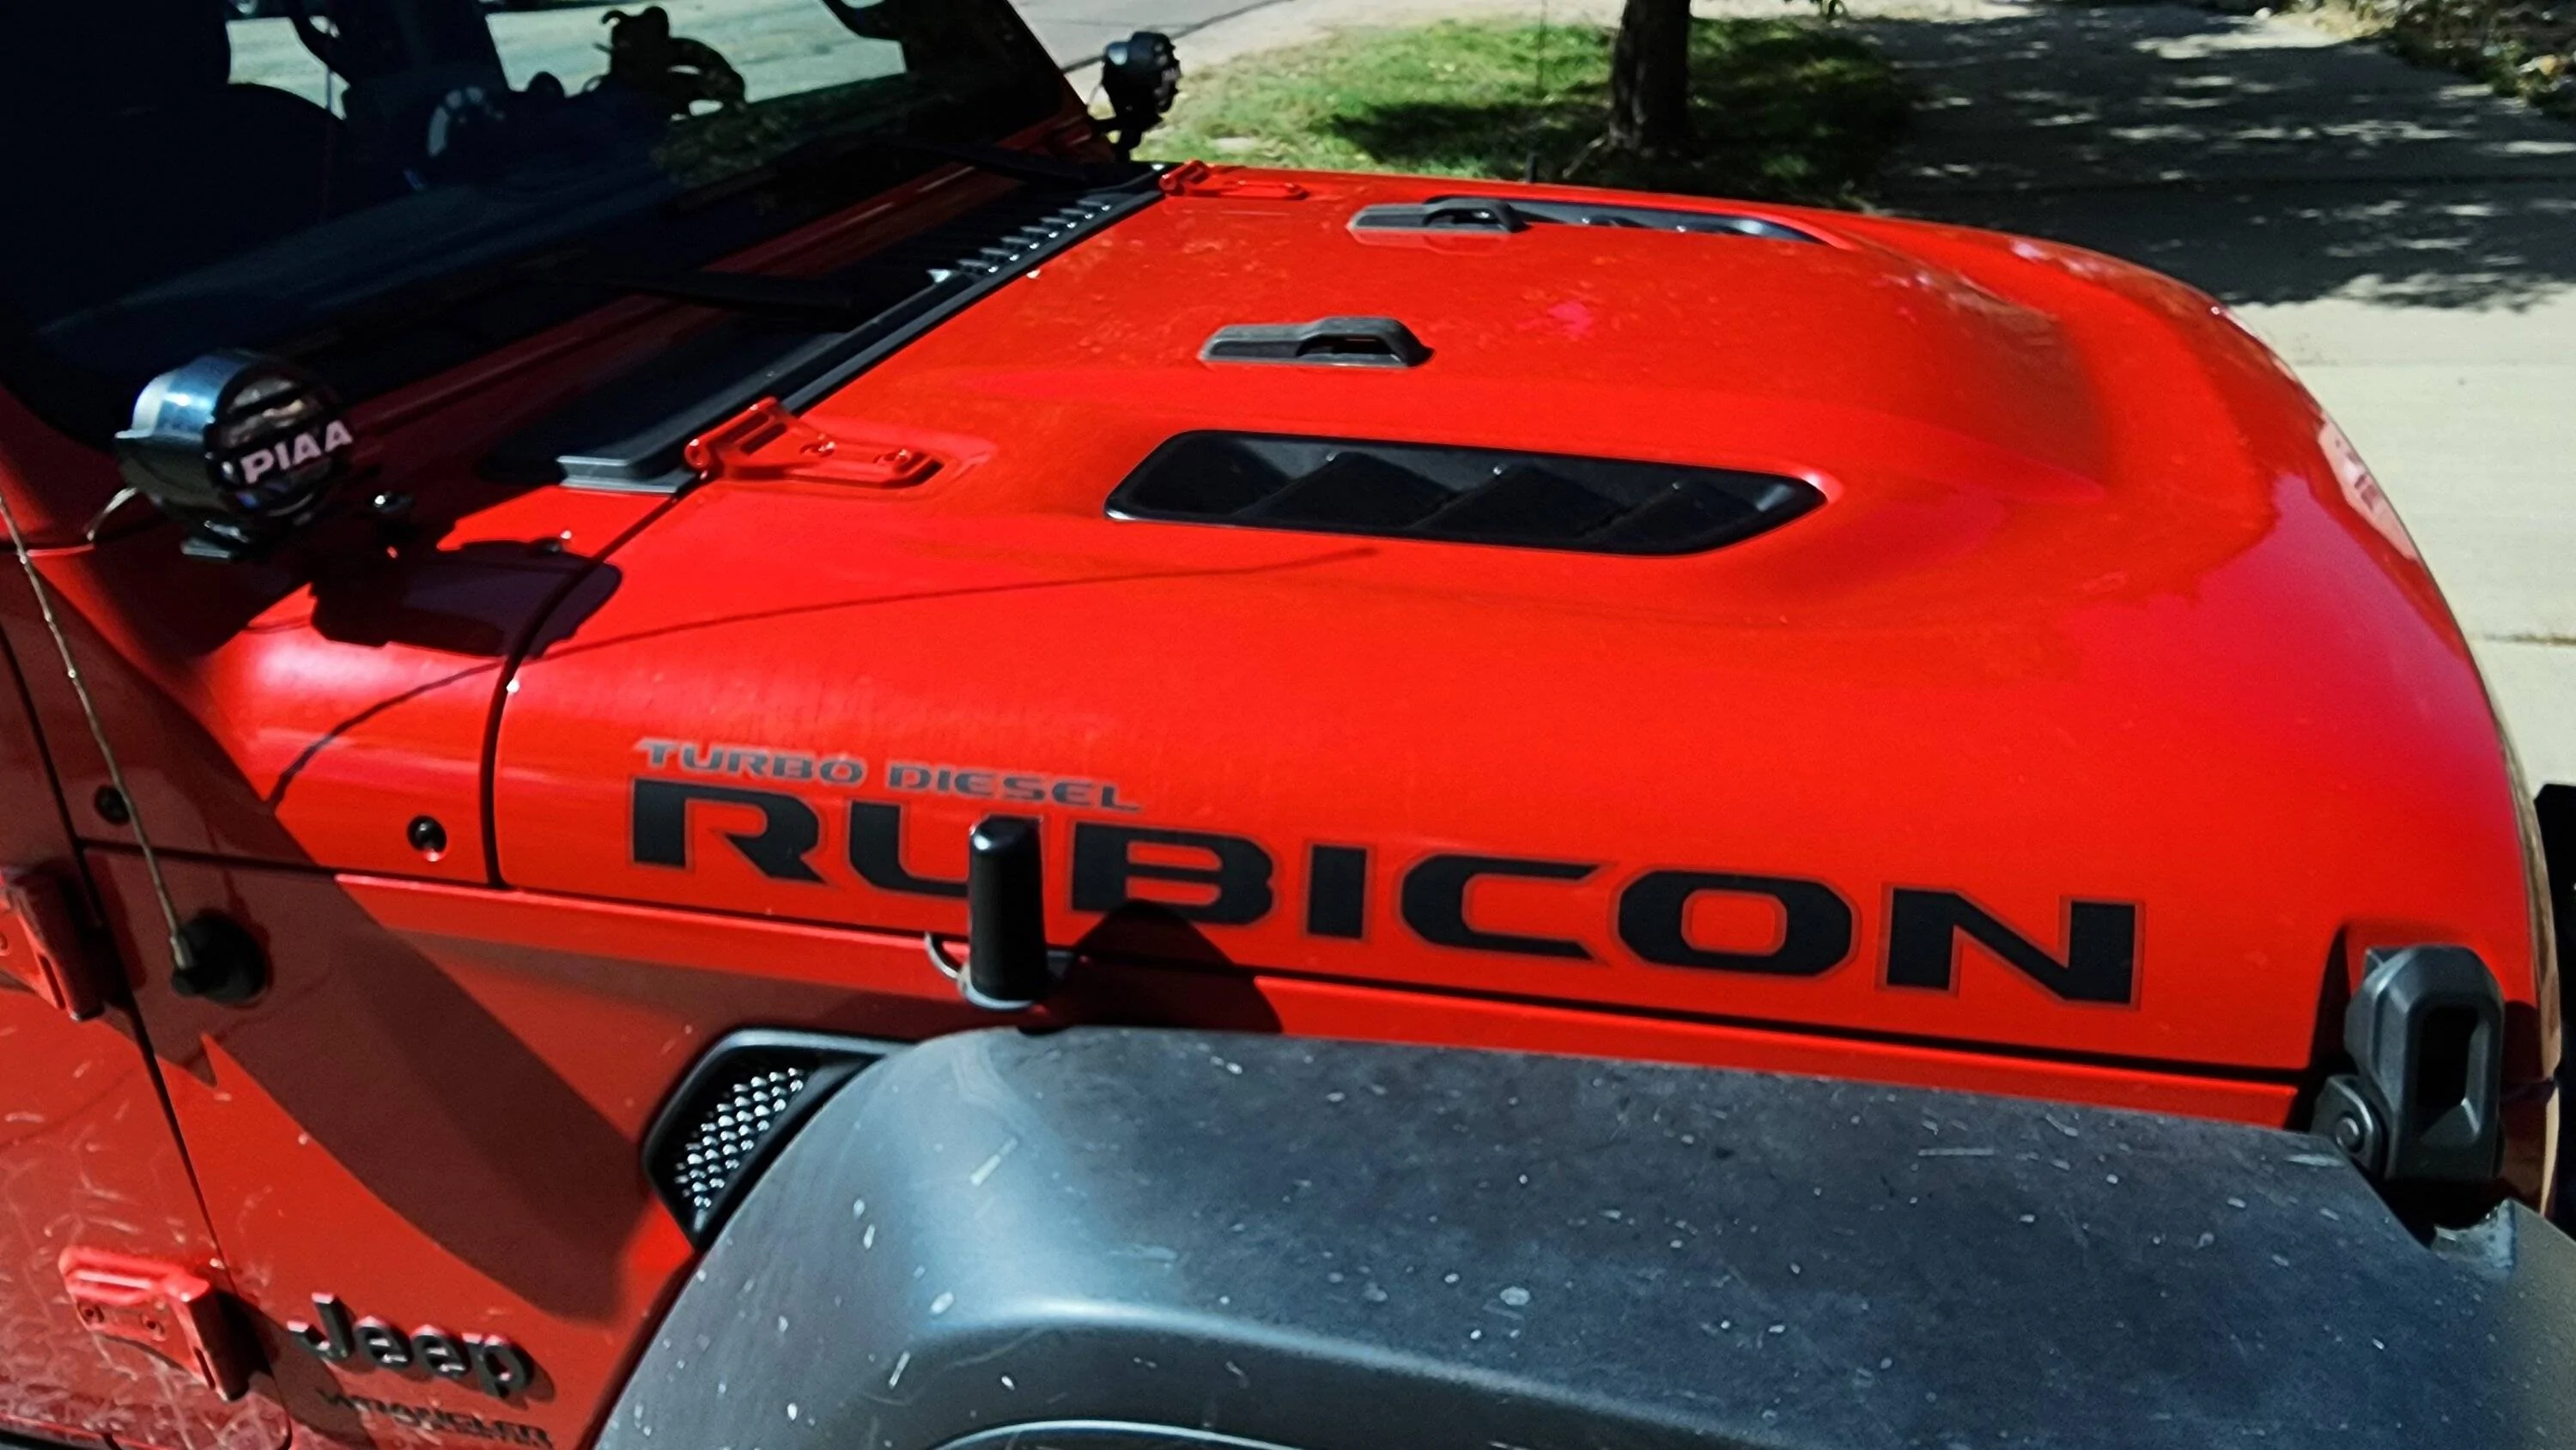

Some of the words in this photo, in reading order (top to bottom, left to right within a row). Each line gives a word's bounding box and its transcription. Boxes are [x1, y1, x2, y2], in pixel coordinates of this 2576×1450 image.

[240, 420, 353, 484] PIAA
[633, 737, 866, 787] TURBO
[886, 760, 1141, 812] DIESEL
[287, 1292, 531, 1399] Jeep
